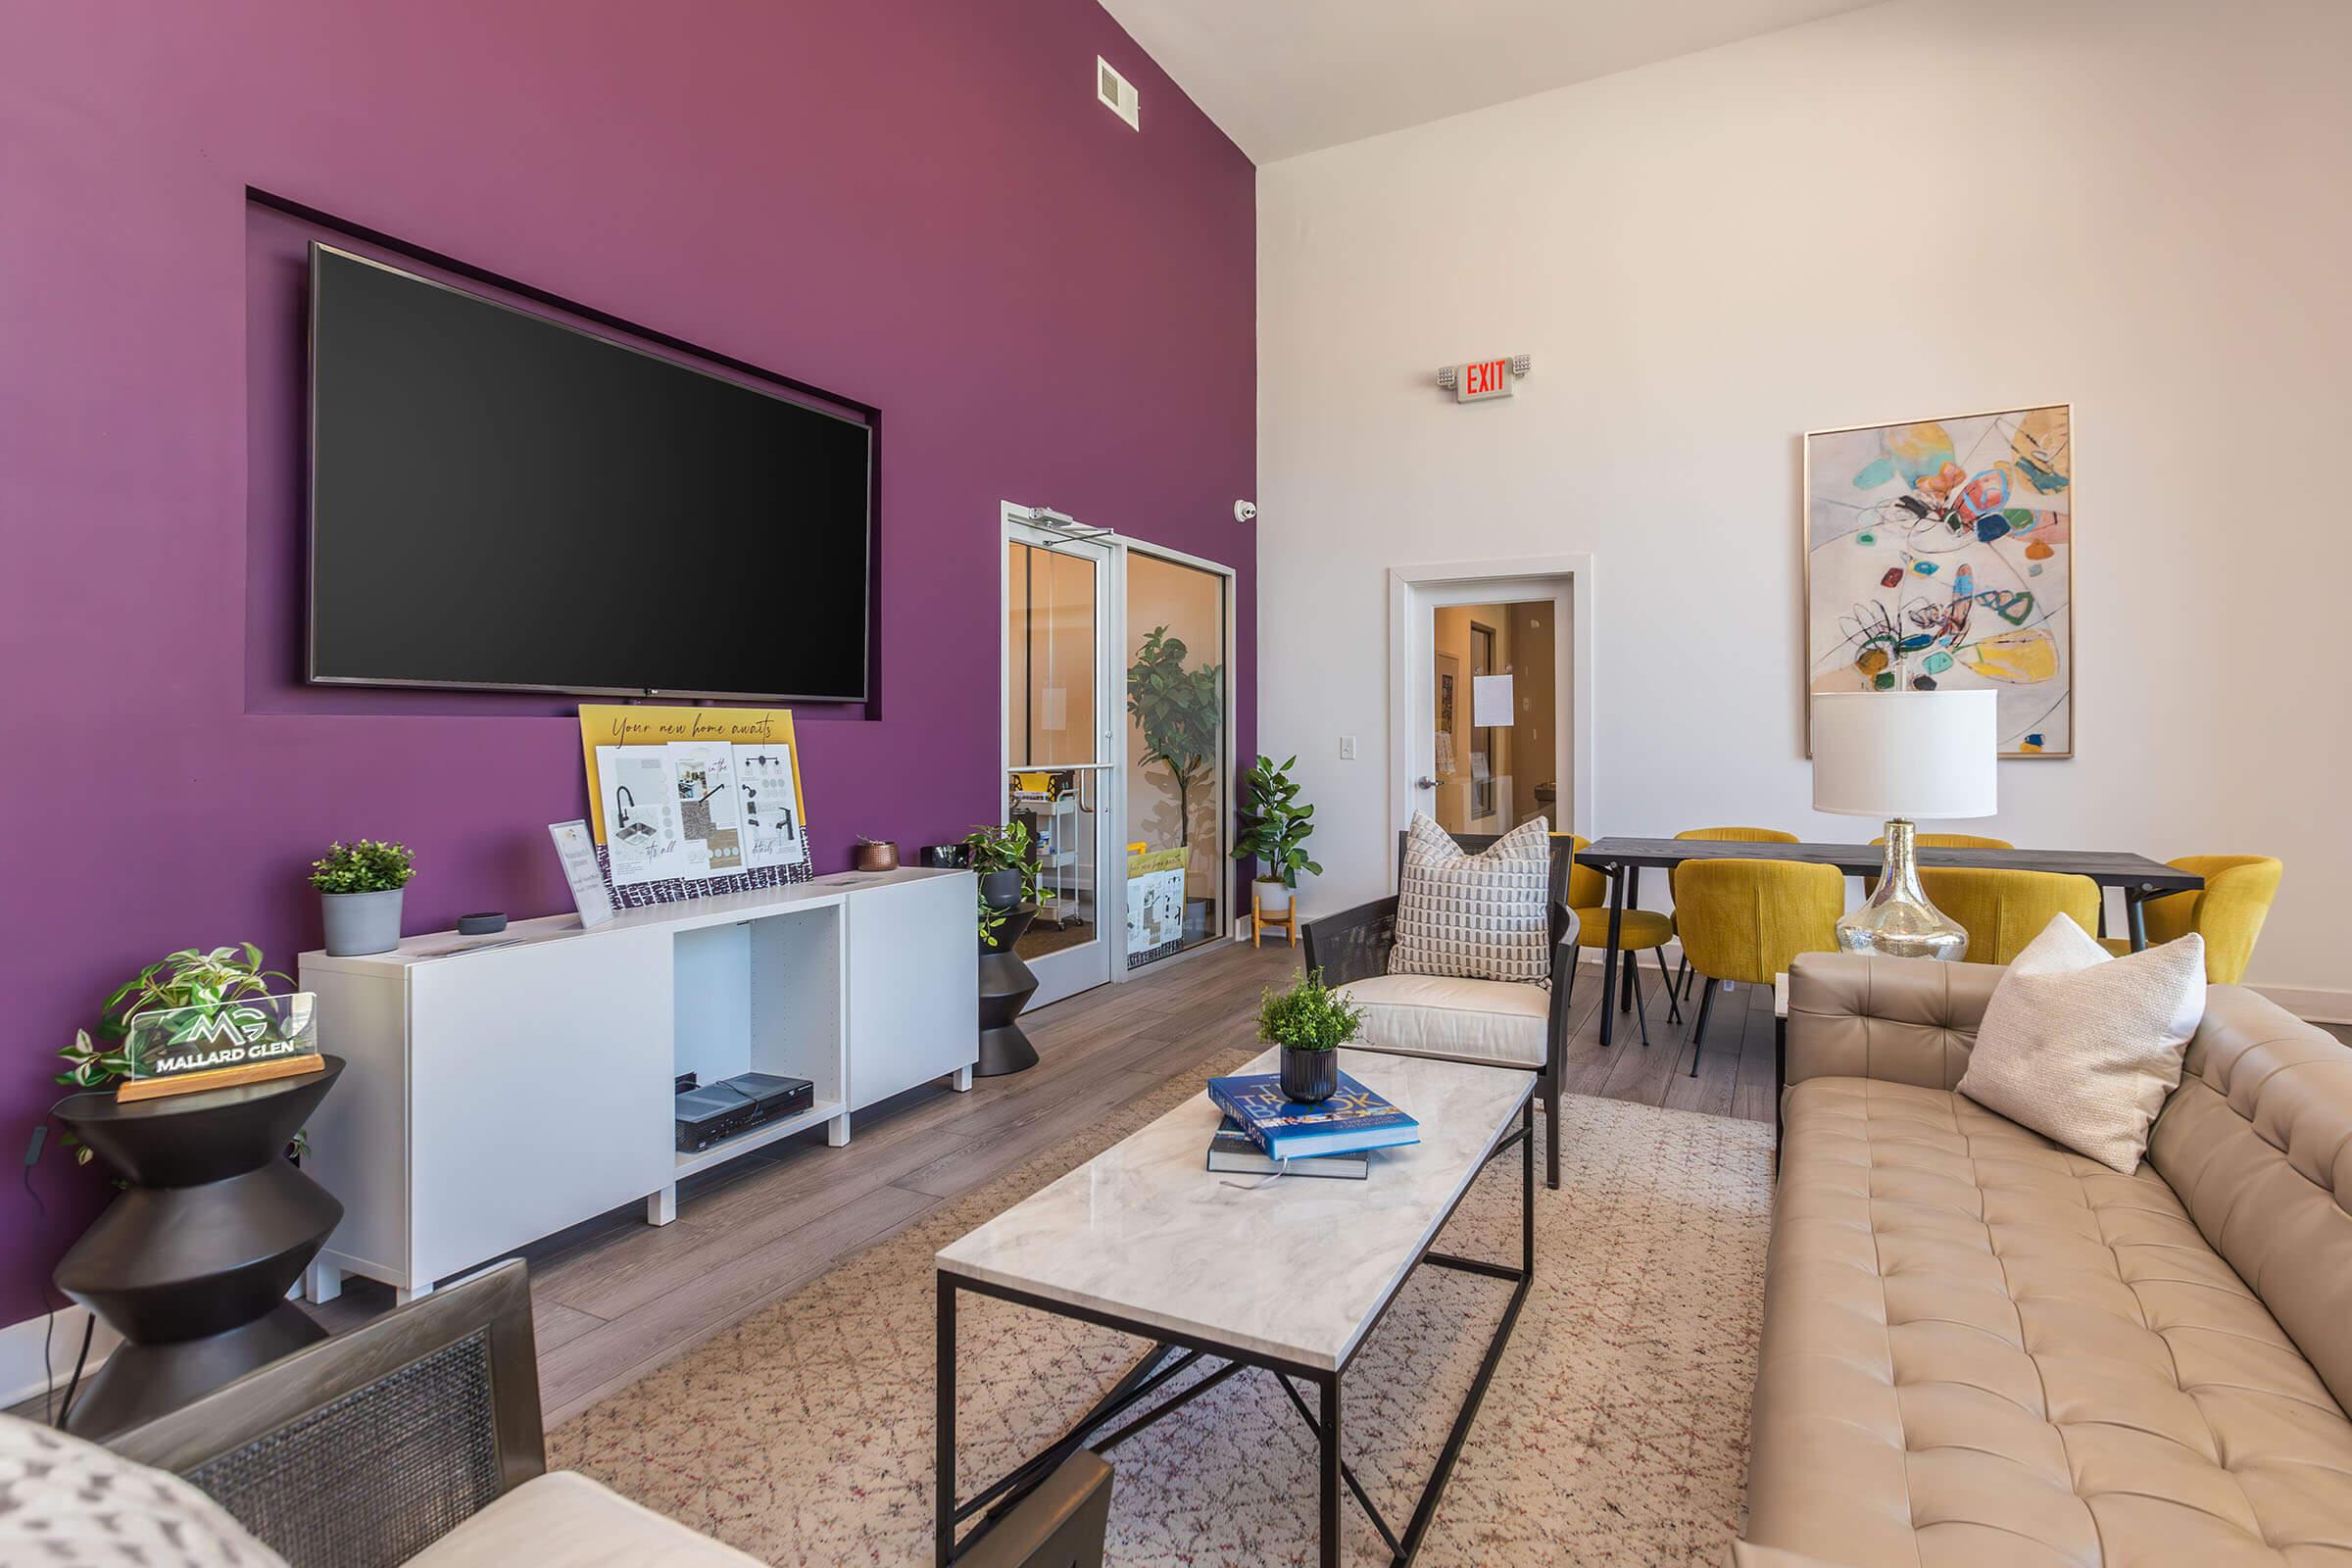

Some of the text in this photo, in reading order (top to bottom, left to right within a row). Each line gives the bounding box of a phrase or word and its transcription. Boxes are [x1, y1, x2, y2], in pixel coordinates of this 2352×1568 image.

[1467, 360, 1506, 394] EXIT
[612, 712, 774, 750] Your new home awaits
[661, 840, 676, 855] all
[156, 1040, 295, 1073] MALLARD GLEN
[1226, 1101, 1247, 1130] TRAVEL
[1248, 1121, 1266, 1151] BOOK
